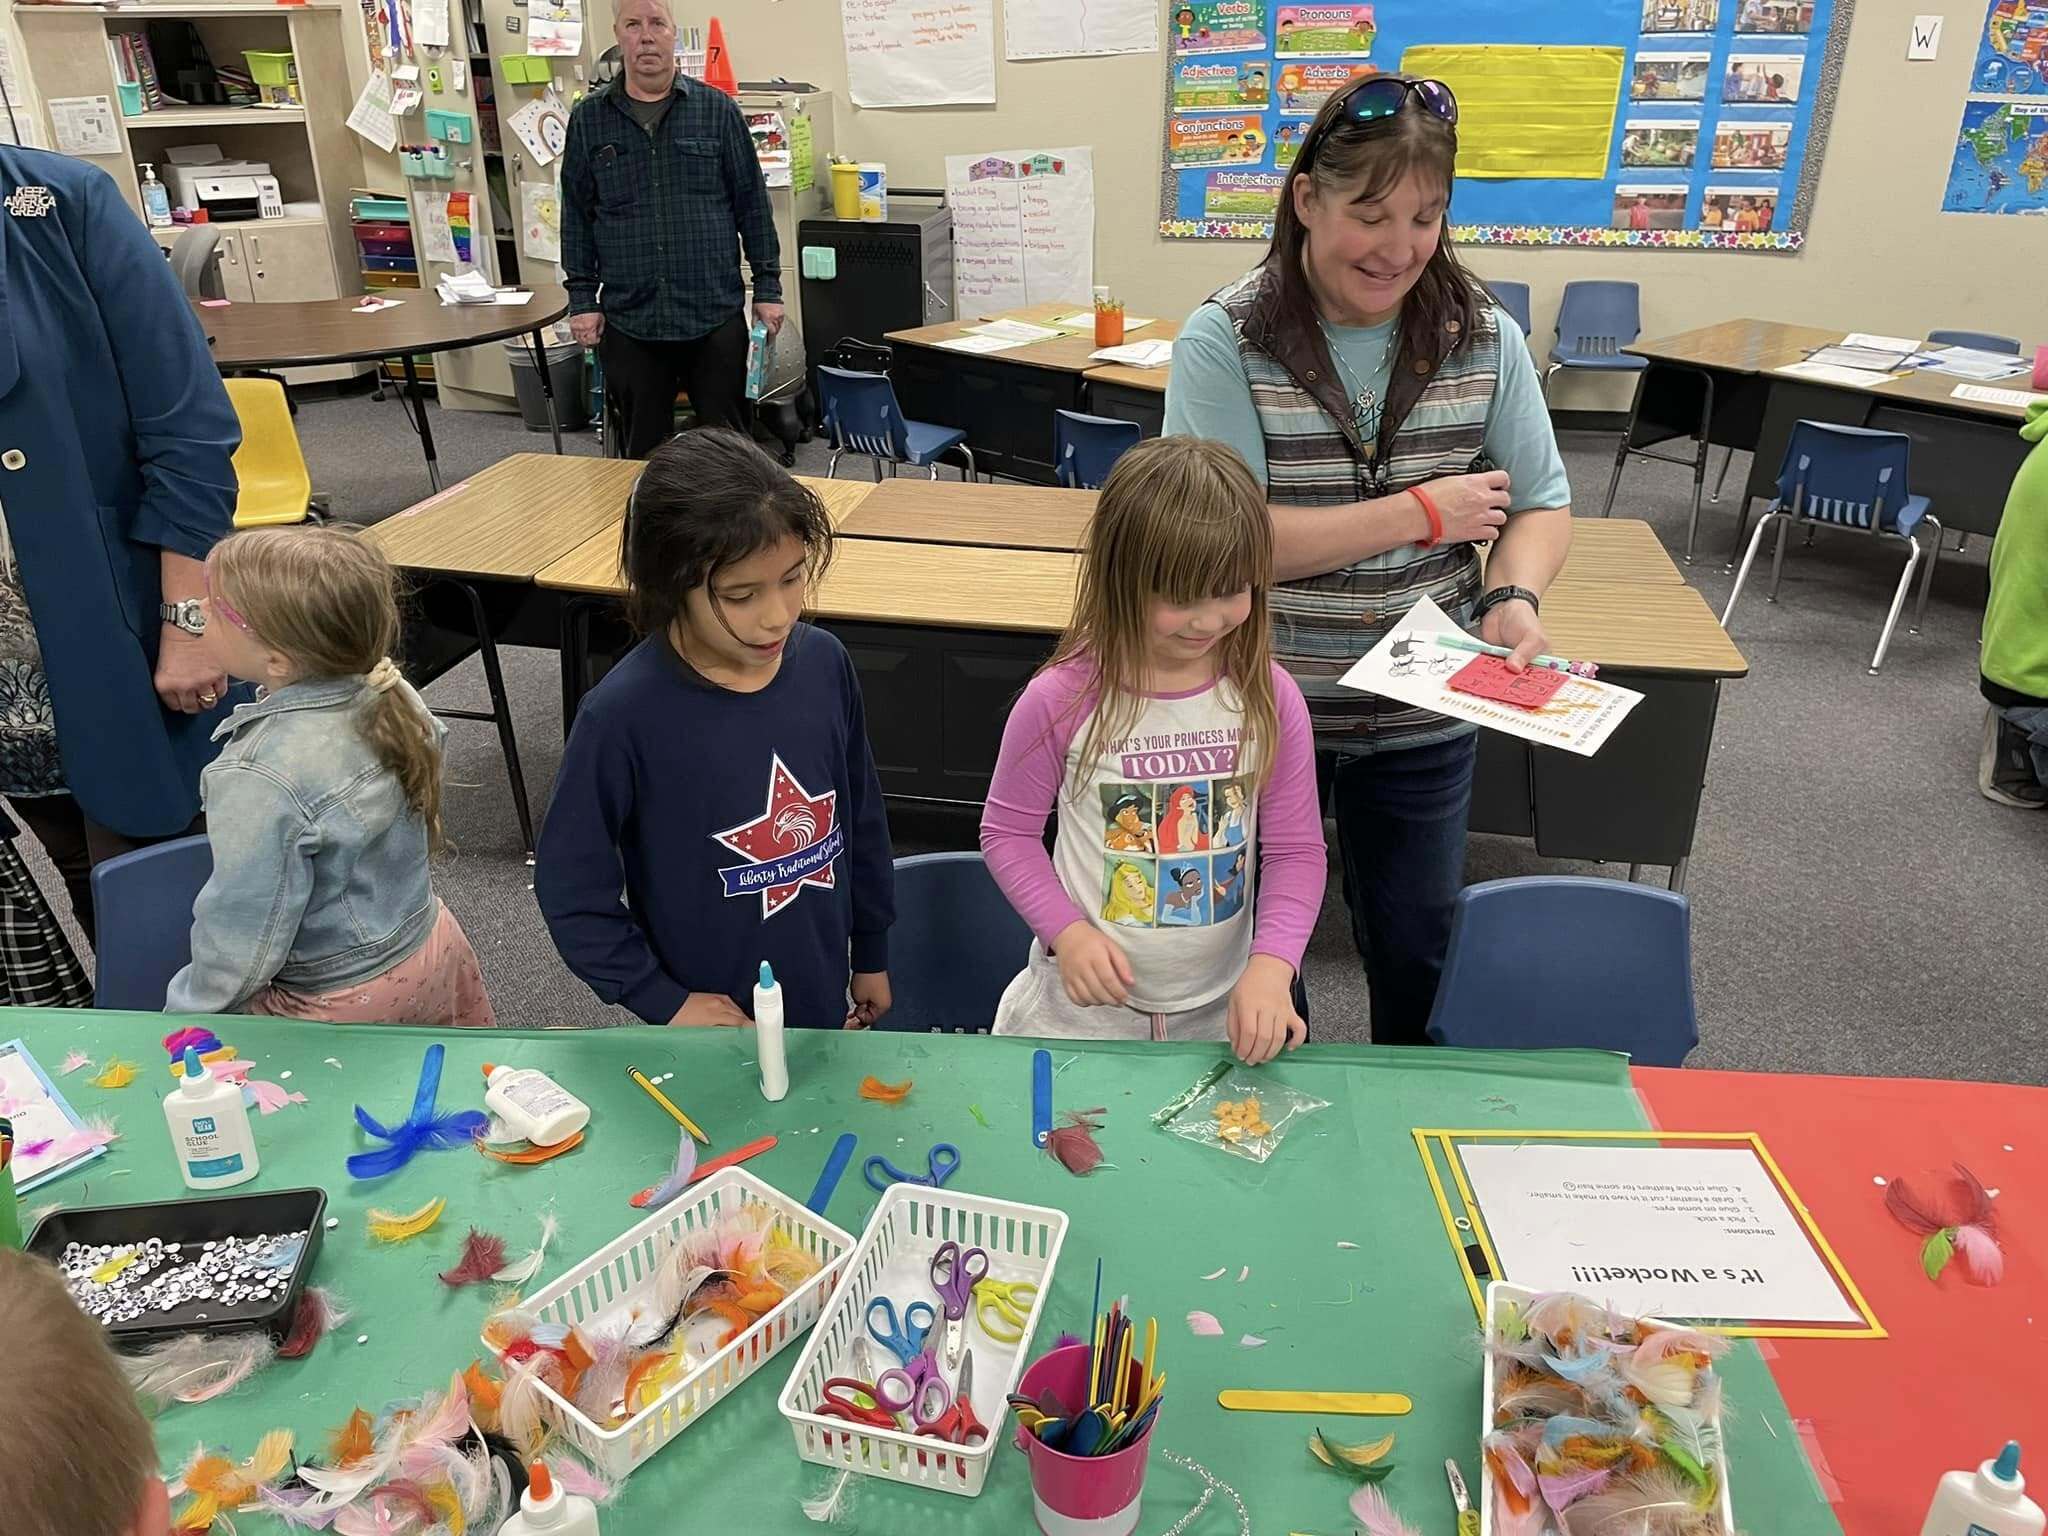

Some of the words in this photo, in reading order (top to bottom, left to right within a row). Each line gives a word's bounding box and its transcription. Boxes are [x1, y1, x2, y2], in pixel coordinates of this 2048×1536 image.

[1217, 2, 1249, 14] Verbs
[1300, 9, 1352, 19] Pronouns
[1914, 22, 1938, 49] W
[709, 46, 720, 64] 7
[1182, 65, 1238, 79] Adjectives
[1304, 66, 1349, 78] Adverbs
[1176, 120, 1244, 134] Conjunctions
[1217, 173, 1286, 188] Interjections
[15, 186, 47, 197] KEEP
[4, 196, 57, 208] AMERICA
[10, 206, 46, 217] GREAT
[1144, 735, 1172, 750] YOUR
[1175, 730, 1223, 747] PRINCESS
[1125, 748, 1234, 777] TODAY?
[739, 869, 777, 886] Liberty
[777, 846, 823, 878] Traditional
[185, 1134, 219, 1142] SCHOOL
[1636, 1184, 1675, 1192] feathers
[1723, 1228, 1775, 1236] Directions:
[1571, 1266, 1700, 1283] Wocket!!!
[1702, 1268, 1718, 1279] a
[1723, 1268, 1765, 1284] It's
